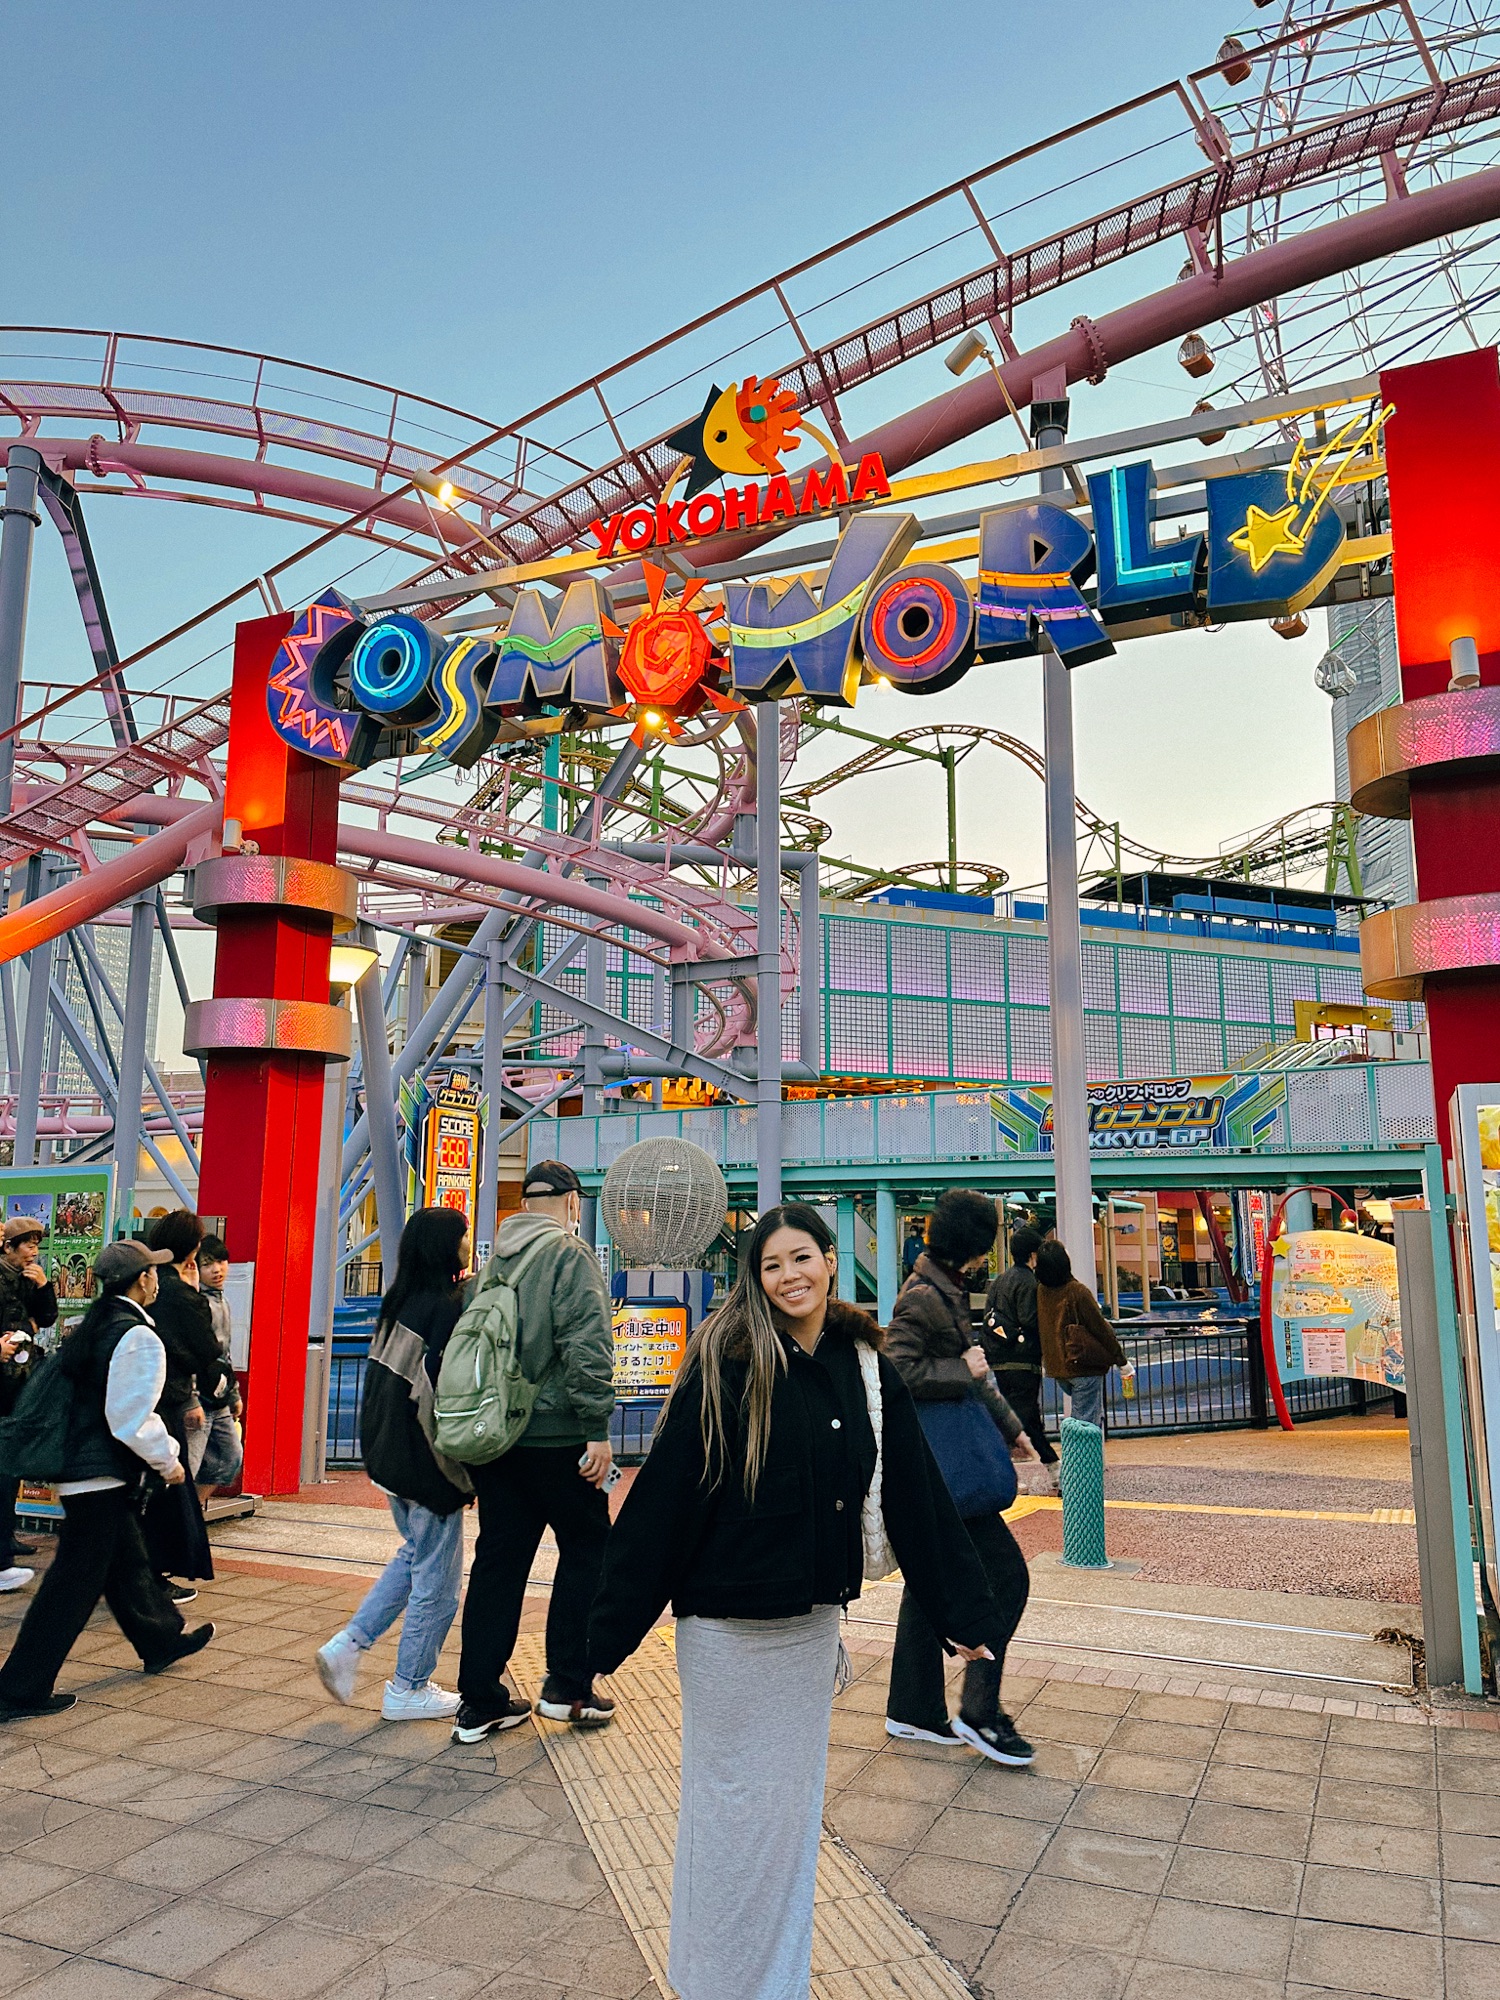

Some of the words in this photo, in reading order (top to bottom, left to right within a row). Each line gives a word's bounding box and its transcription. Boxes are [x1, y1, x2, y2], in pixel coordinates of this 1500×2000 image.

[587, 451, 892, 560] YOKOHAMA
[267, 560, 743, 770] COSMO
[723, 458, 1348, 708] WORLD
[441, 1116, 474, 1136] SCORE
[440, 1138, 464, 1166] 268
[438, 1175, 472, 1187] RANKING
